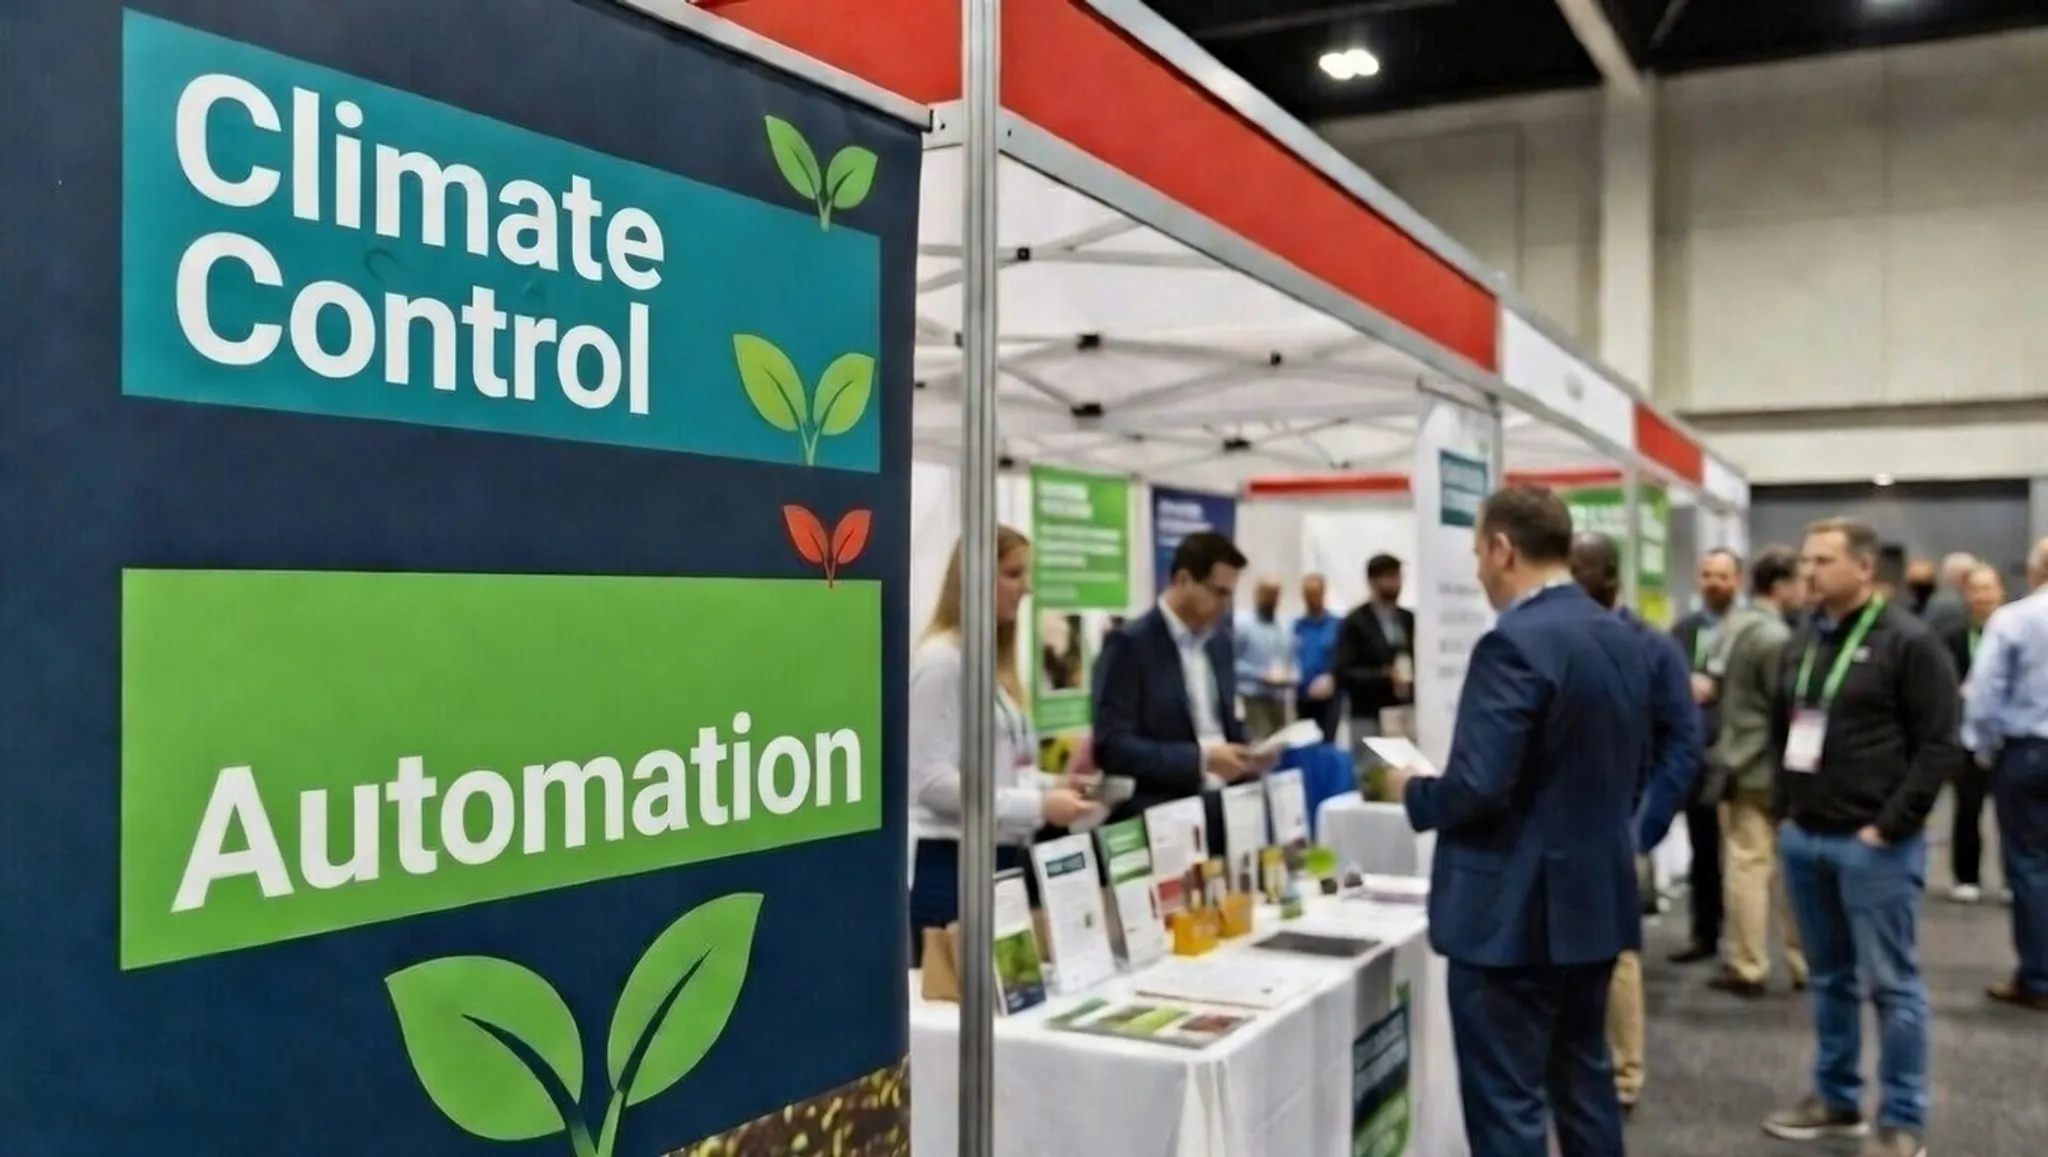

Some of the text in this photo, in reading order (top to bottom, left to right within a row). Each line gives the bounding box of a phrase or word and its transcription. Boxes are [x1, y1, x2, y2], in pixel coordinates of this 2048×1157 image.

[176, 74, 664, 290] Climate
[177, 232, 649, 414] Control
[174, 712, 861, 911] Automation
